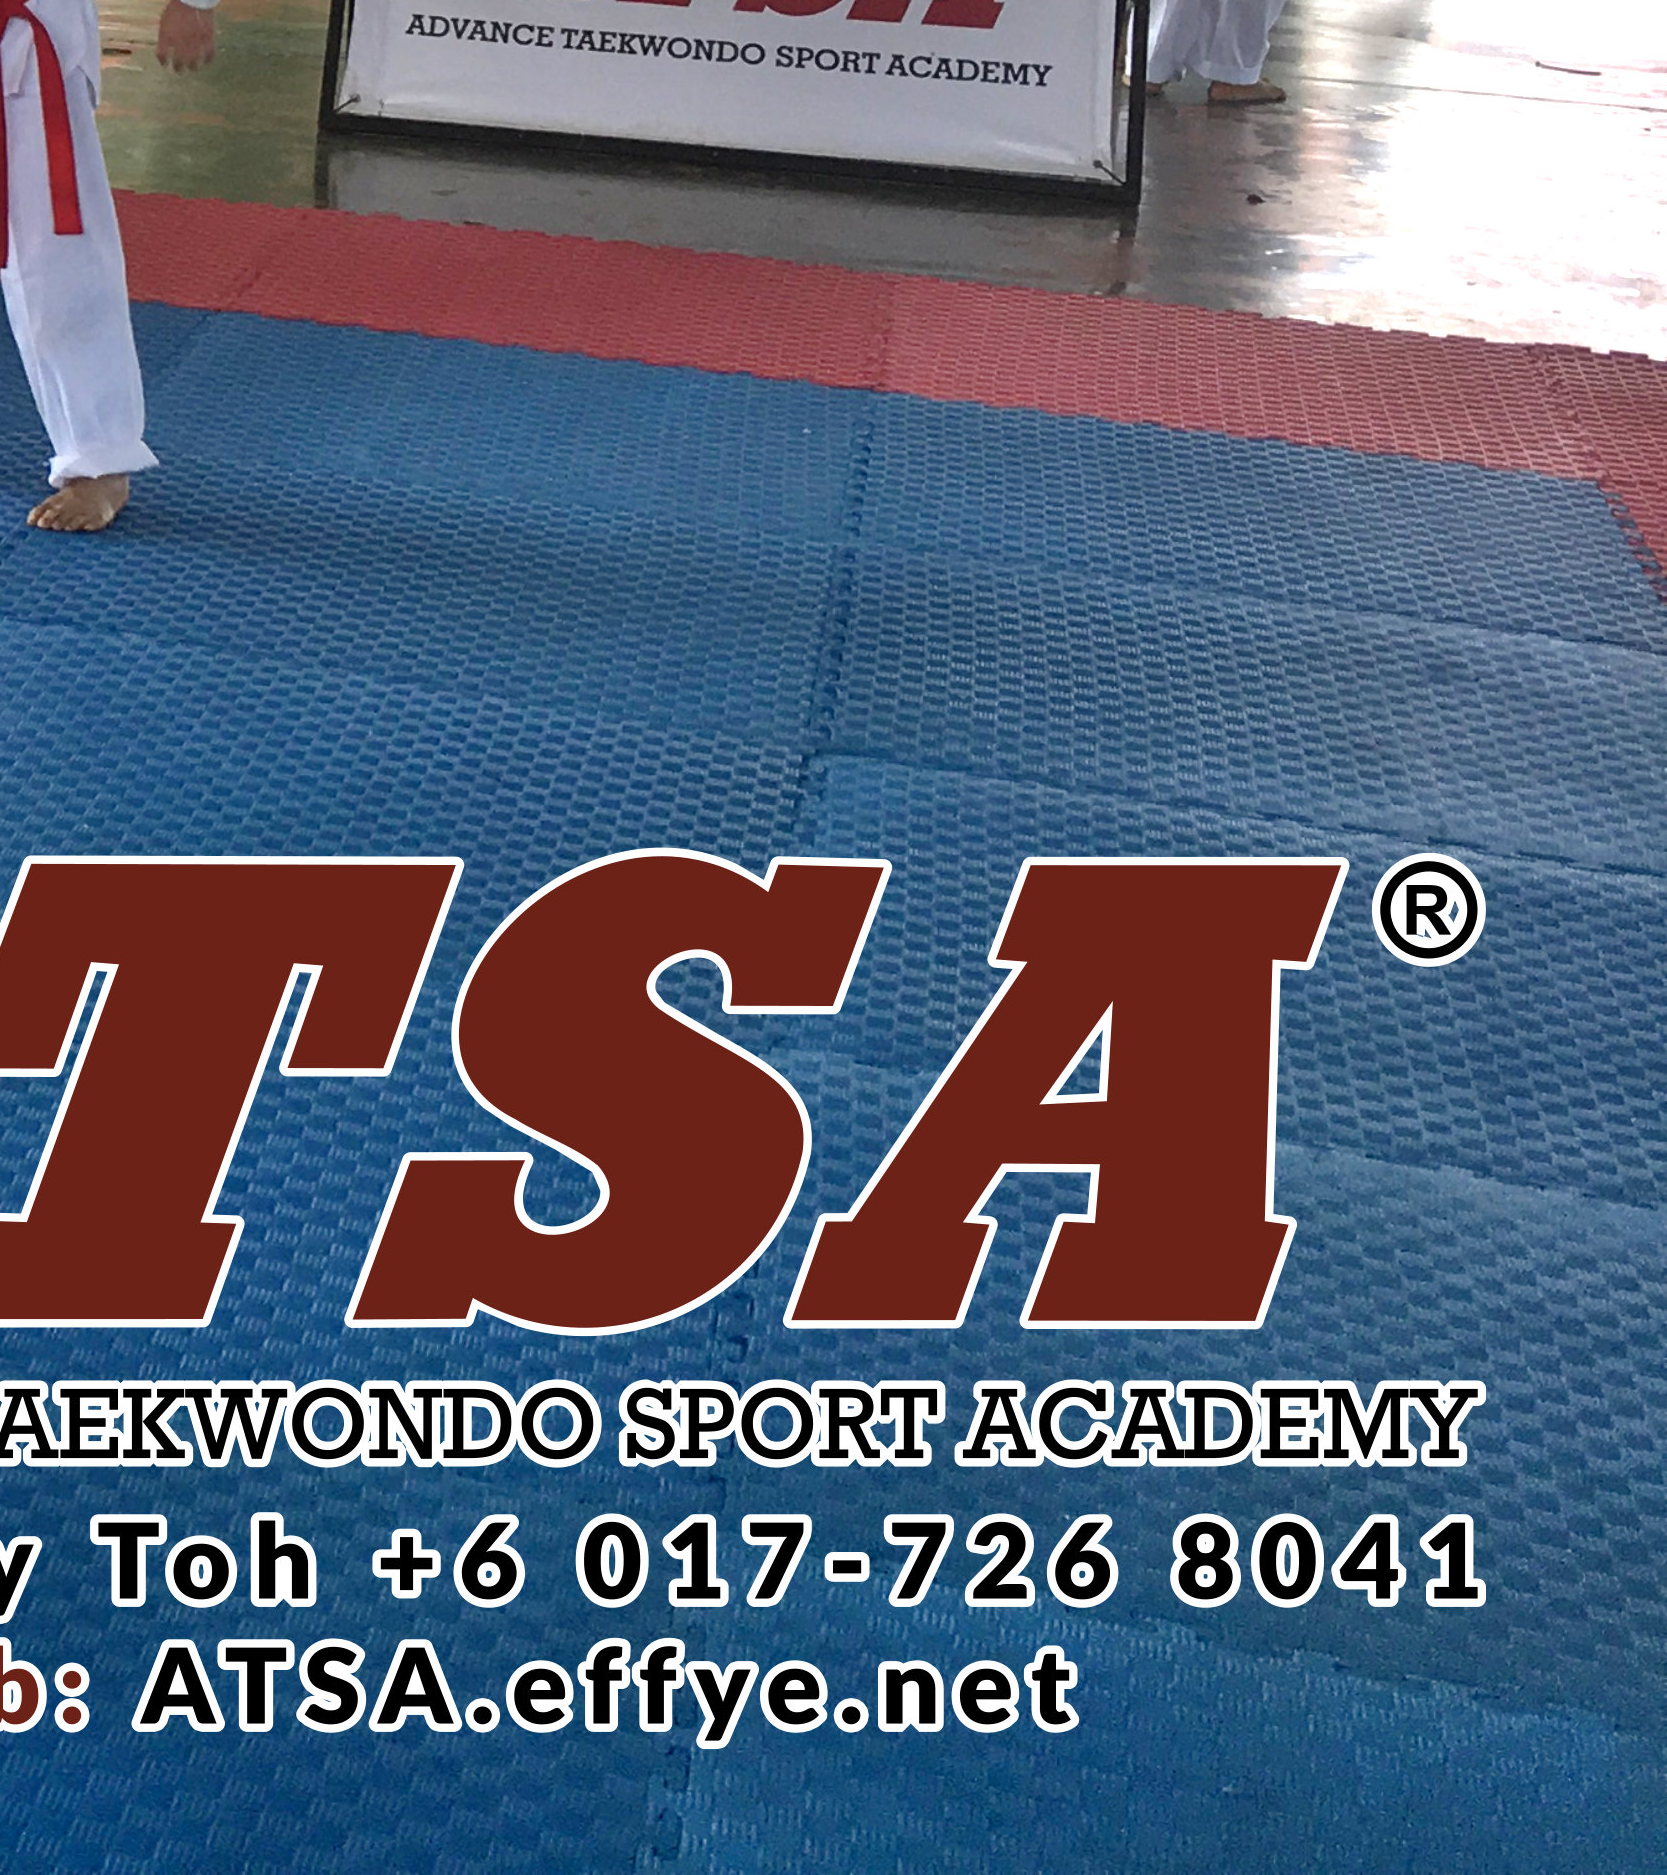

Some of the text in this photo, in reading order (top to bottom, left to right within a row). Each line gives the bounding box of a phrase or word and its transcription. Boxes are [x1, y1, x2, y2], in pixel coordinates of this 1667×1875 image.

[405, 13, 1053, 89] ADVANCE TAEKWONDO SPORT ACADEMY
